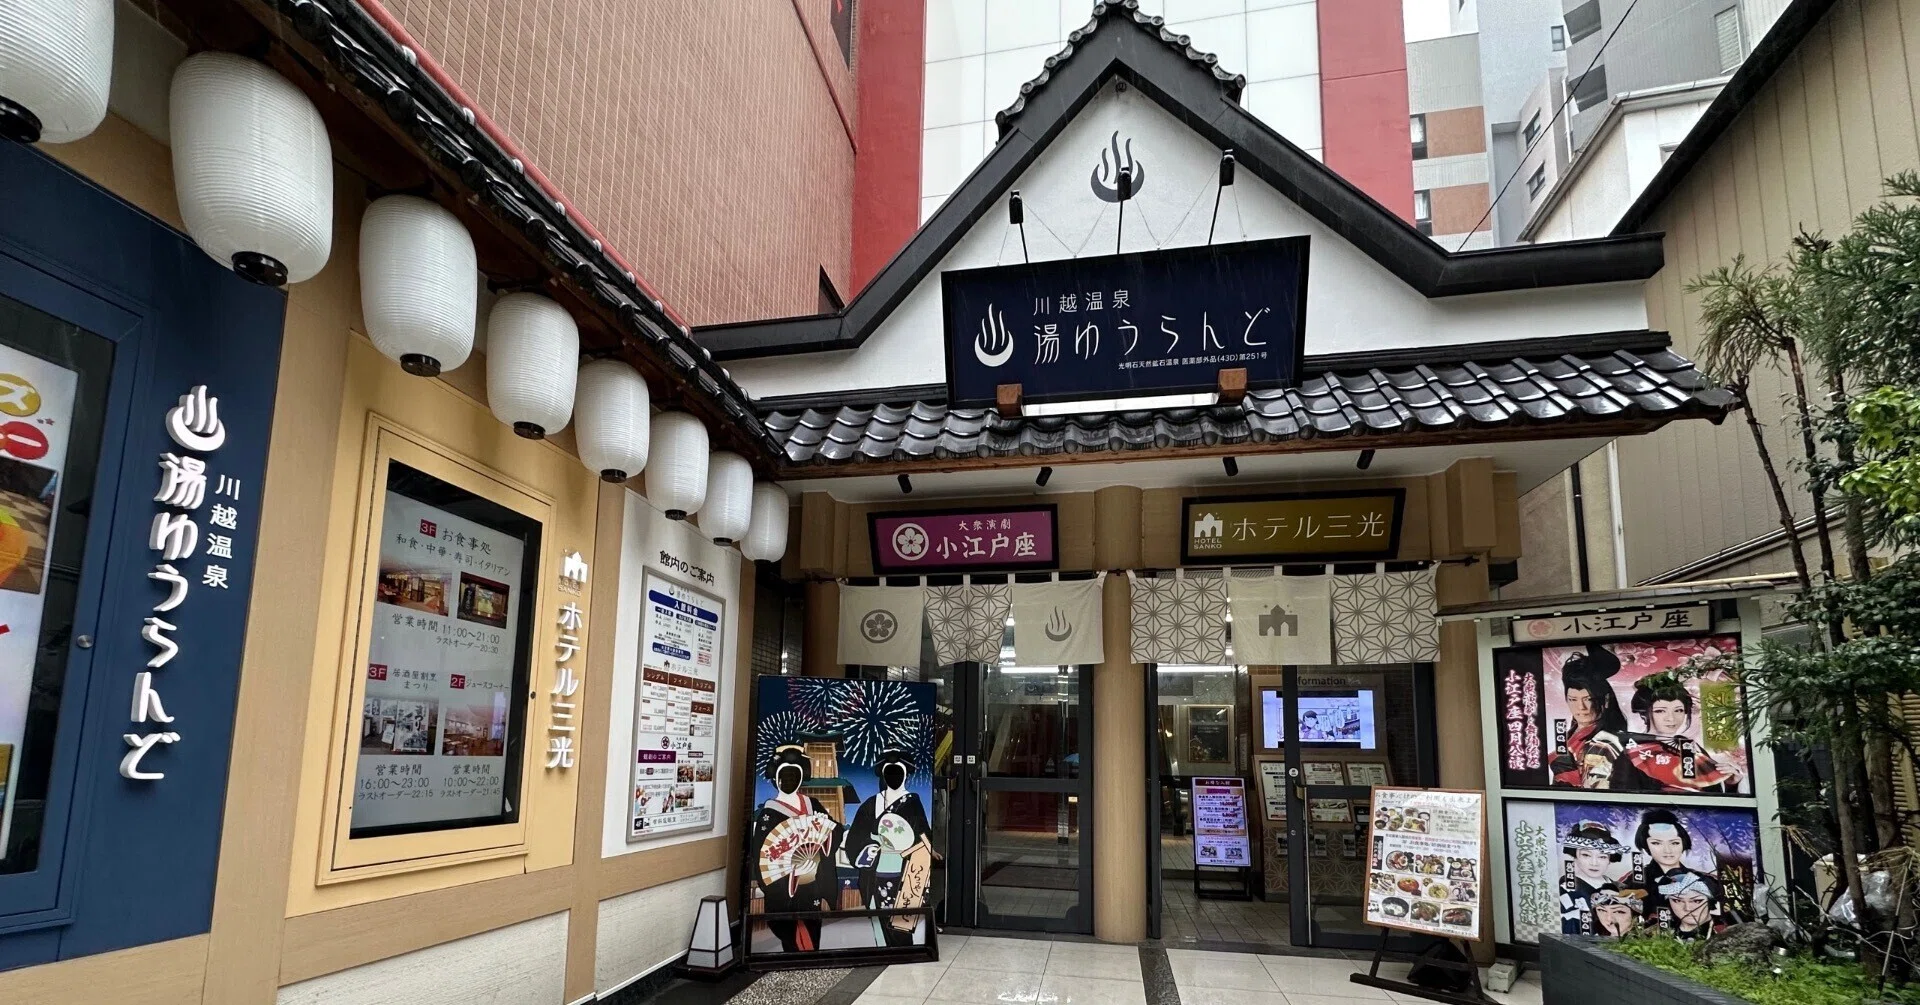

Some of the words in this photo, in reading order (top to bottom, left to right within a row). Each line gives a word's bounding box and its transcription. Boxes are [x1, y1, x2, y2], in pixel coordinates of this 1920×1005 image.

[1033, 289, 1130, 316] 川越温泉
[1033, 307, 1270, 365] 湯ゆうらんど
[202, 475, 240, 590] 川越温泉
[420, 522, 436, 535] 3F
[958, 518, 1011, 531] 大衆演劇
[1231, 511, 1385, 541] ホテル三光
[442, 528, 491, 555] お食事処
[936, 531, 1037, 560] 小江戸座
[659, 550, 715, 587] 館内のご案内
[118, 452, 207, 783] 湯ゆうらんど
[392, 613, 438, 633] 営業時間
[1562, 609, 1694, 635] 小江戸座
[369, 666, 386, 678] 3F
[403, 680, 429, 690] まつり
[451, 677, 465, 687] 2F
[1298, 676, 1346, 686] formation
[545, 602, 582, 770] ホテル三光
[376, 763, 422, 775] 営業時間
[453, 764, 491, 775] 営業時間
